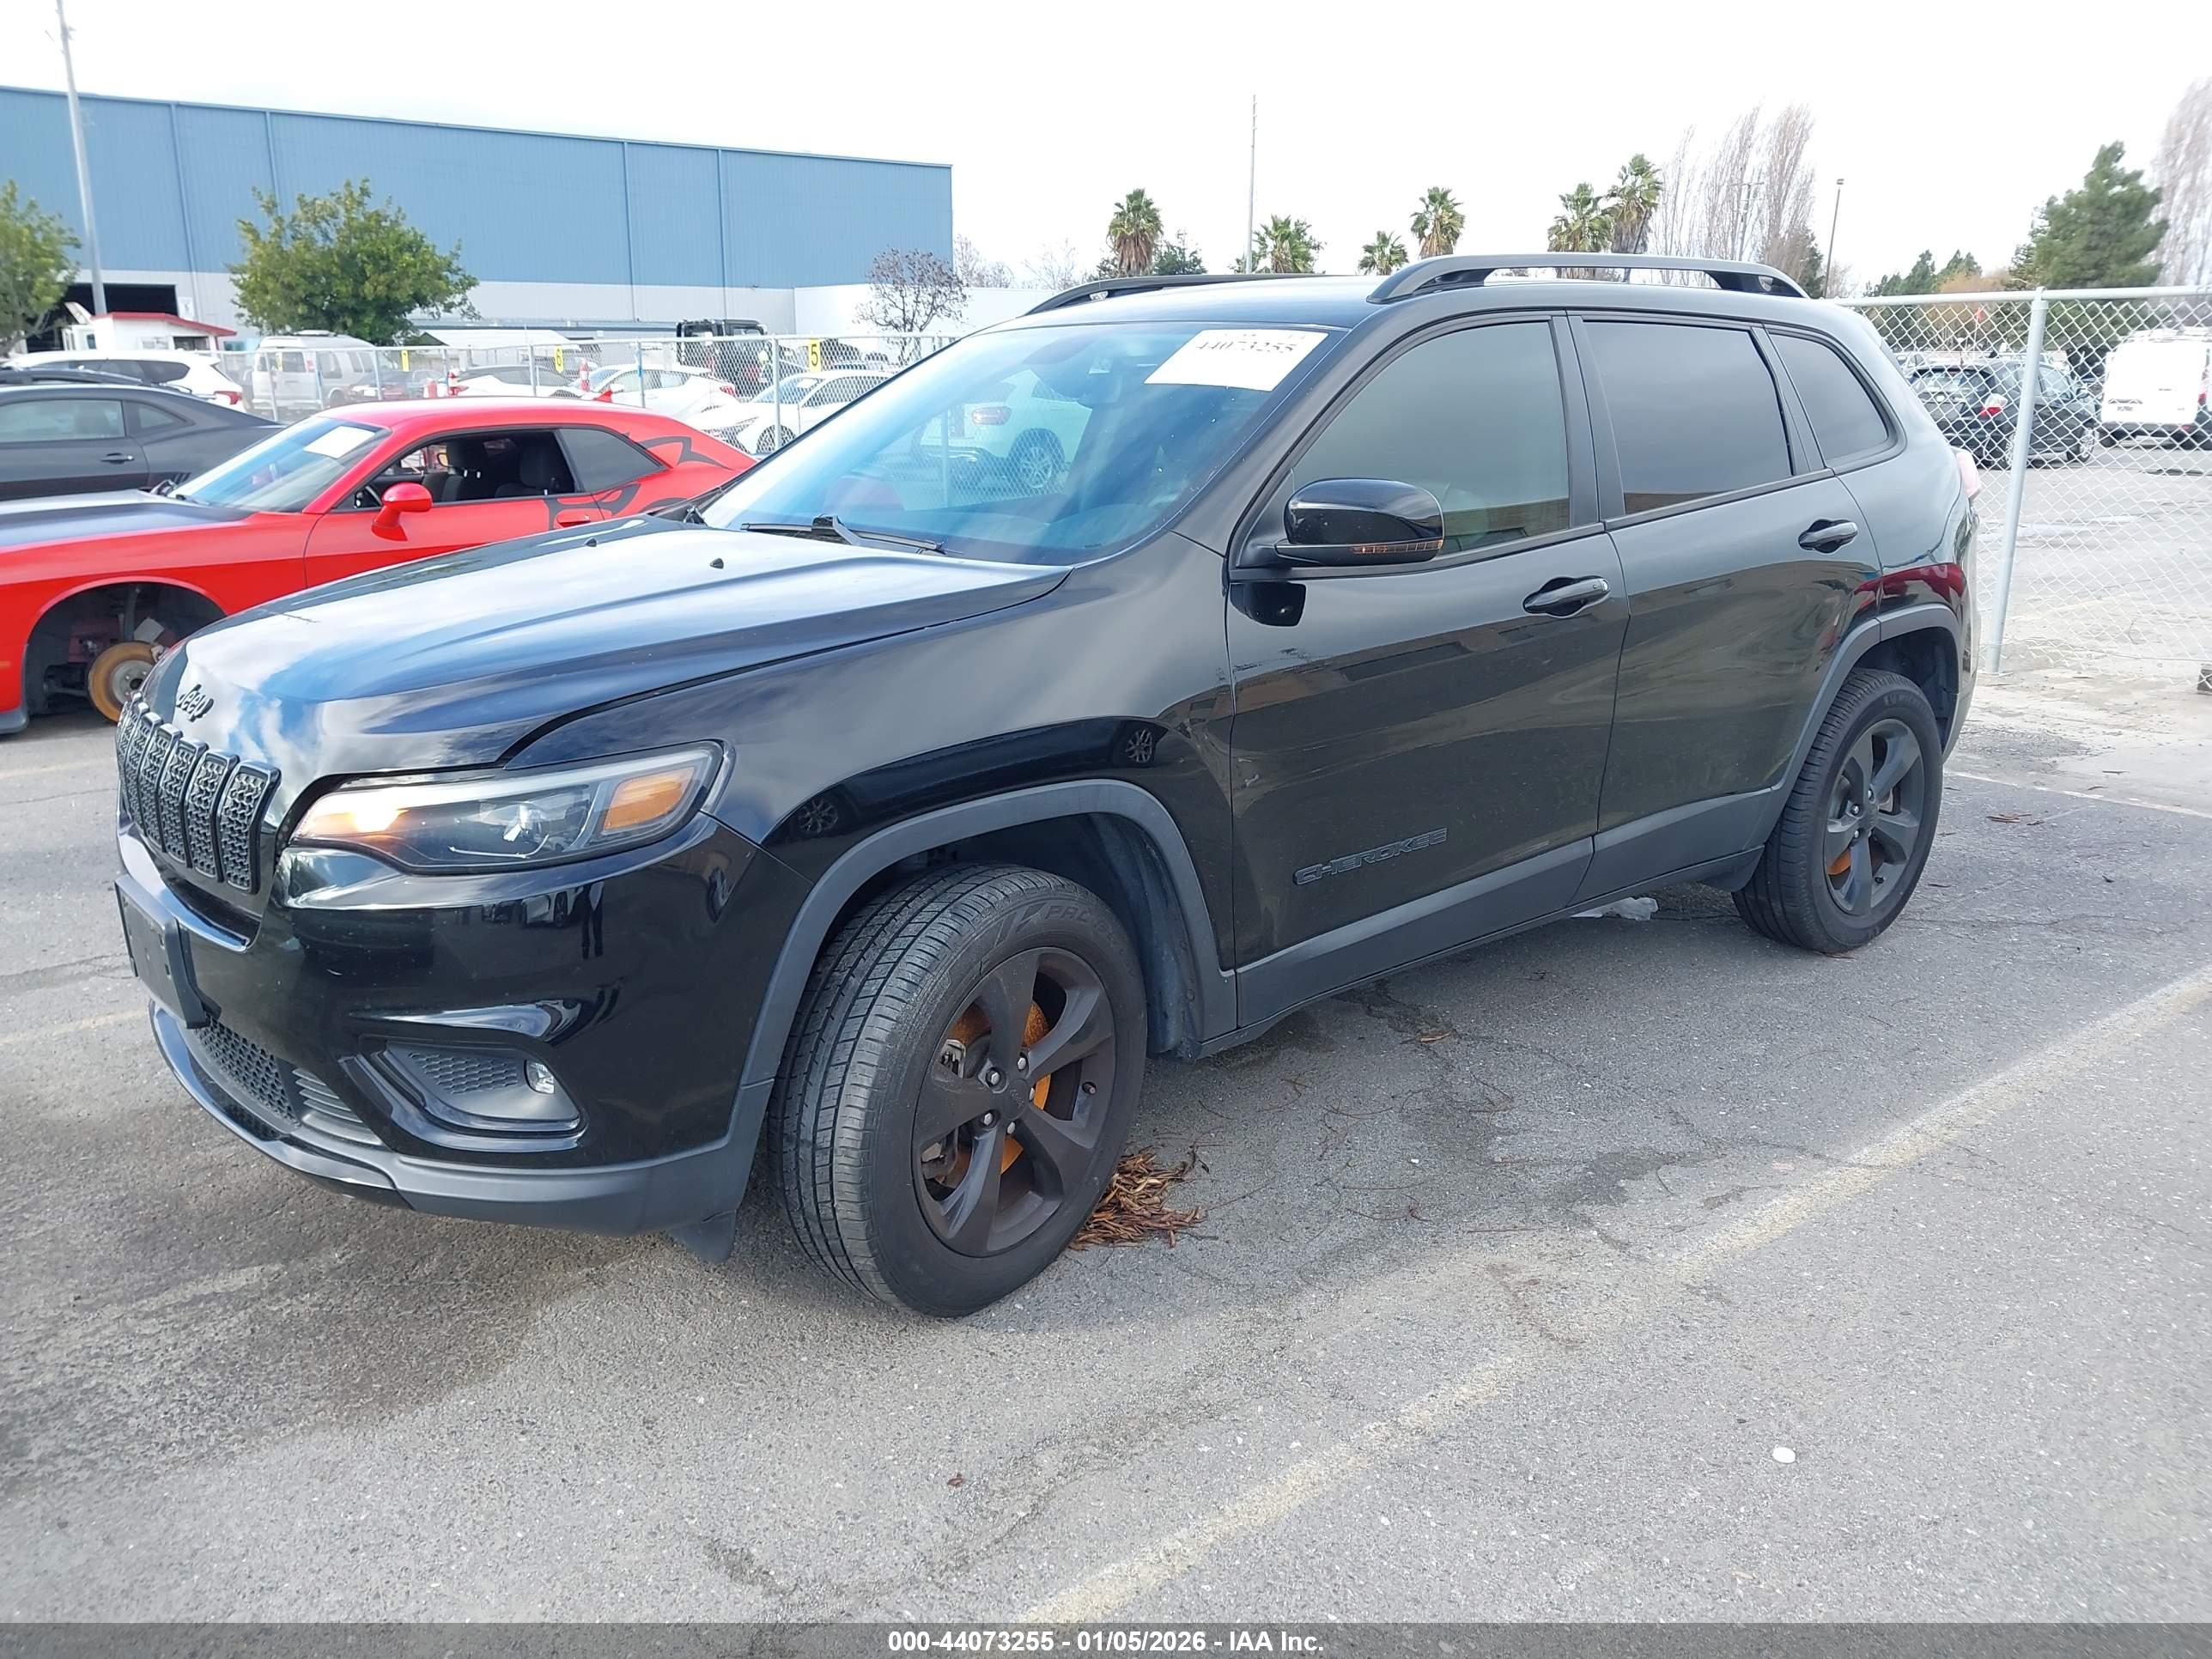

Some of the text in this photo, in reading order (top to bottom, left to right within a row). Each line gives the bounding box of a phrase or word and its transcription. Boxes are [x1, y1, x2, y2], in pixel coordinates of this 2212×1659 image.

[811, 343, 818, 367] 5
[176, 684, 214, 722] Jeep
[1293, 827, 1448, 885] CHEROKEE
